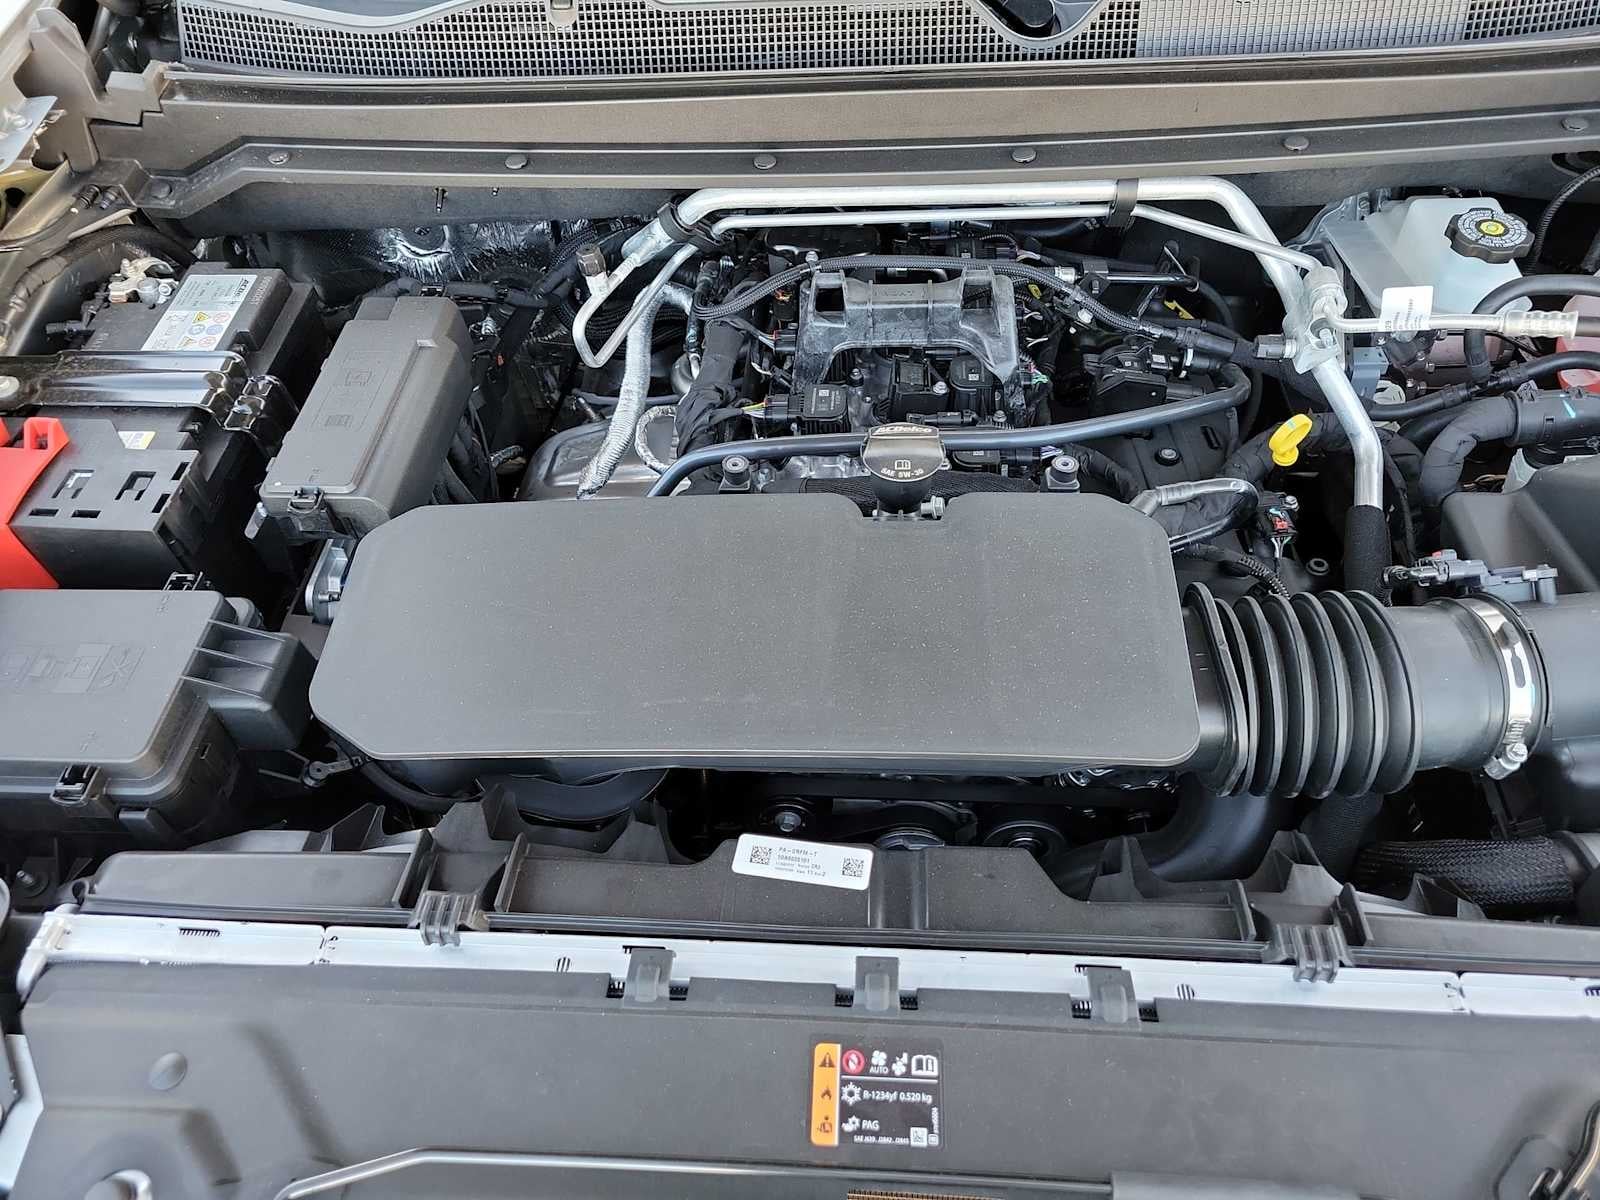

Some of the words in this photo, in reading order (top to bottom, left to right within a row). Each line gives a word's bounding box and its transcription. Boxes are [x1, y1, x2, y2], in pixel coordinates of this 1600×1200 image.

[874, 426, 932, 434] ACDelco
[881, 467, 896, 477] SAE
[869, 1066, 889, 1074] AUTO
[863, 1090, 898, 1103] R-1234yf
[899, 1091, 920, 1100] 0.520
[921, 1092, 933, 1105] kg
[862, 1120, 880, 1131] PAG
